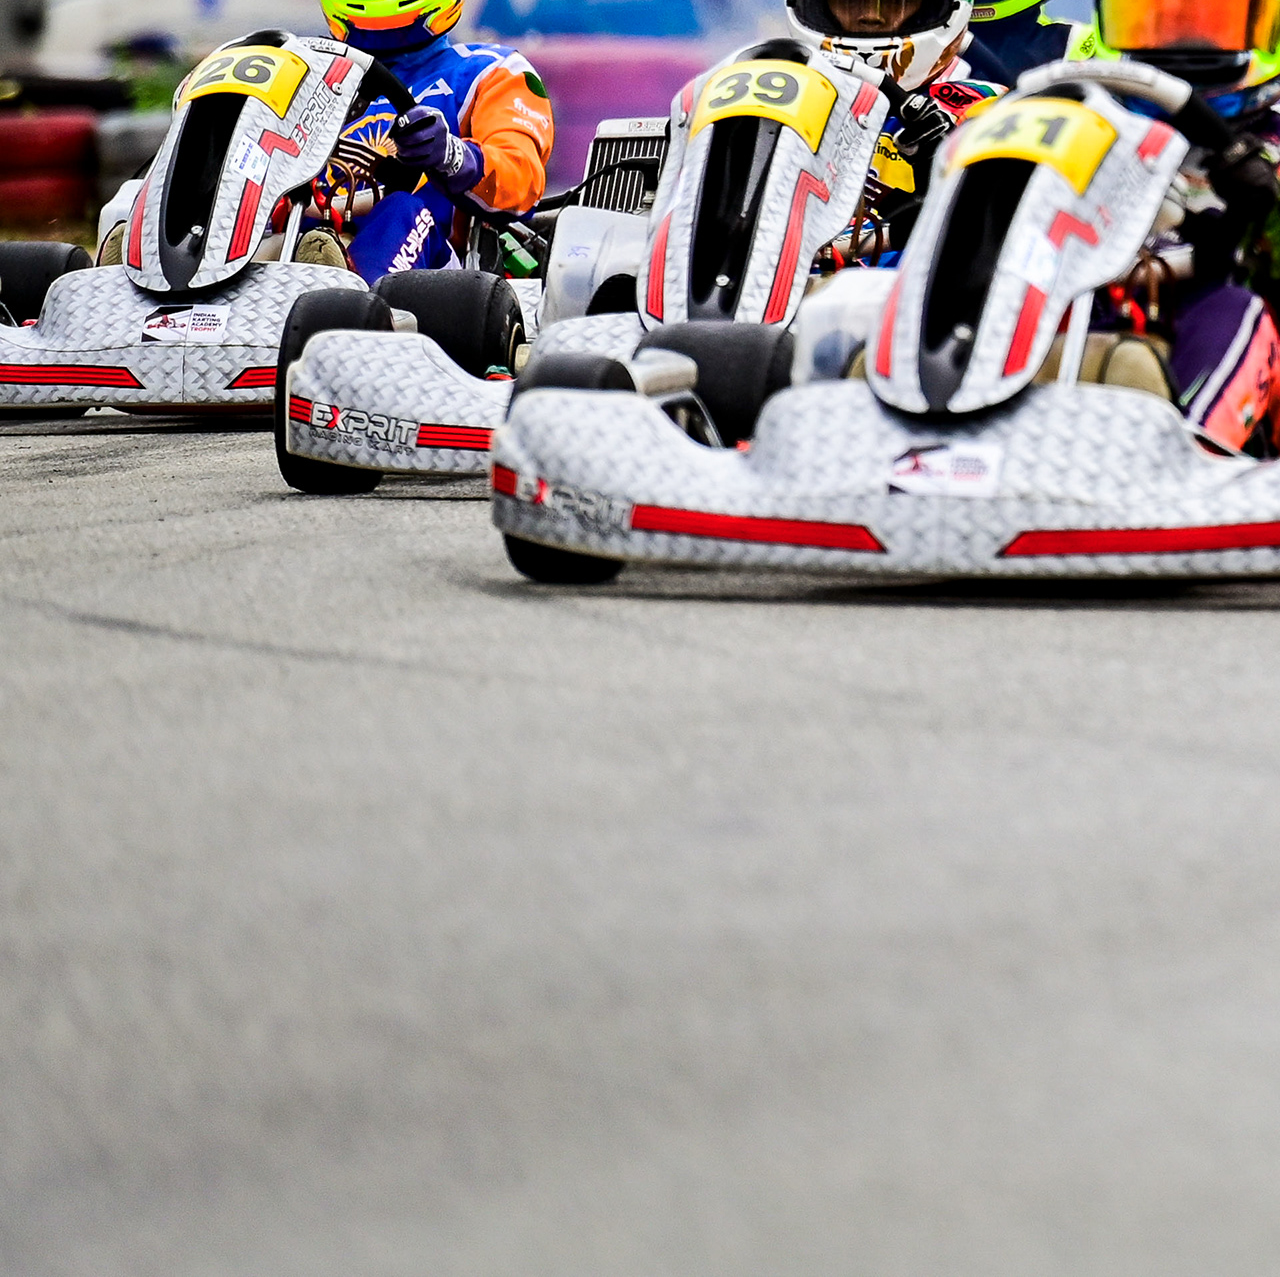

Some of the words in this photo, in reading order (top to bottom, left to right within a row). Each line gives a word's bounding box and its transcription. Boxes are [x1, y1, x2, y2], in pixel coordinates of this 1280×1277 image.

[190, 54, 276, 92] 26
[708, 71, 800, 109] 39
[939, 85, 974, 106] OMP
[289, 80, 331, 151] EXPRIT
[977, 112, 1070, 147] 41
[307, 429, 364, 447] RACING
[310, 401, 420, 445] EXPRIT
